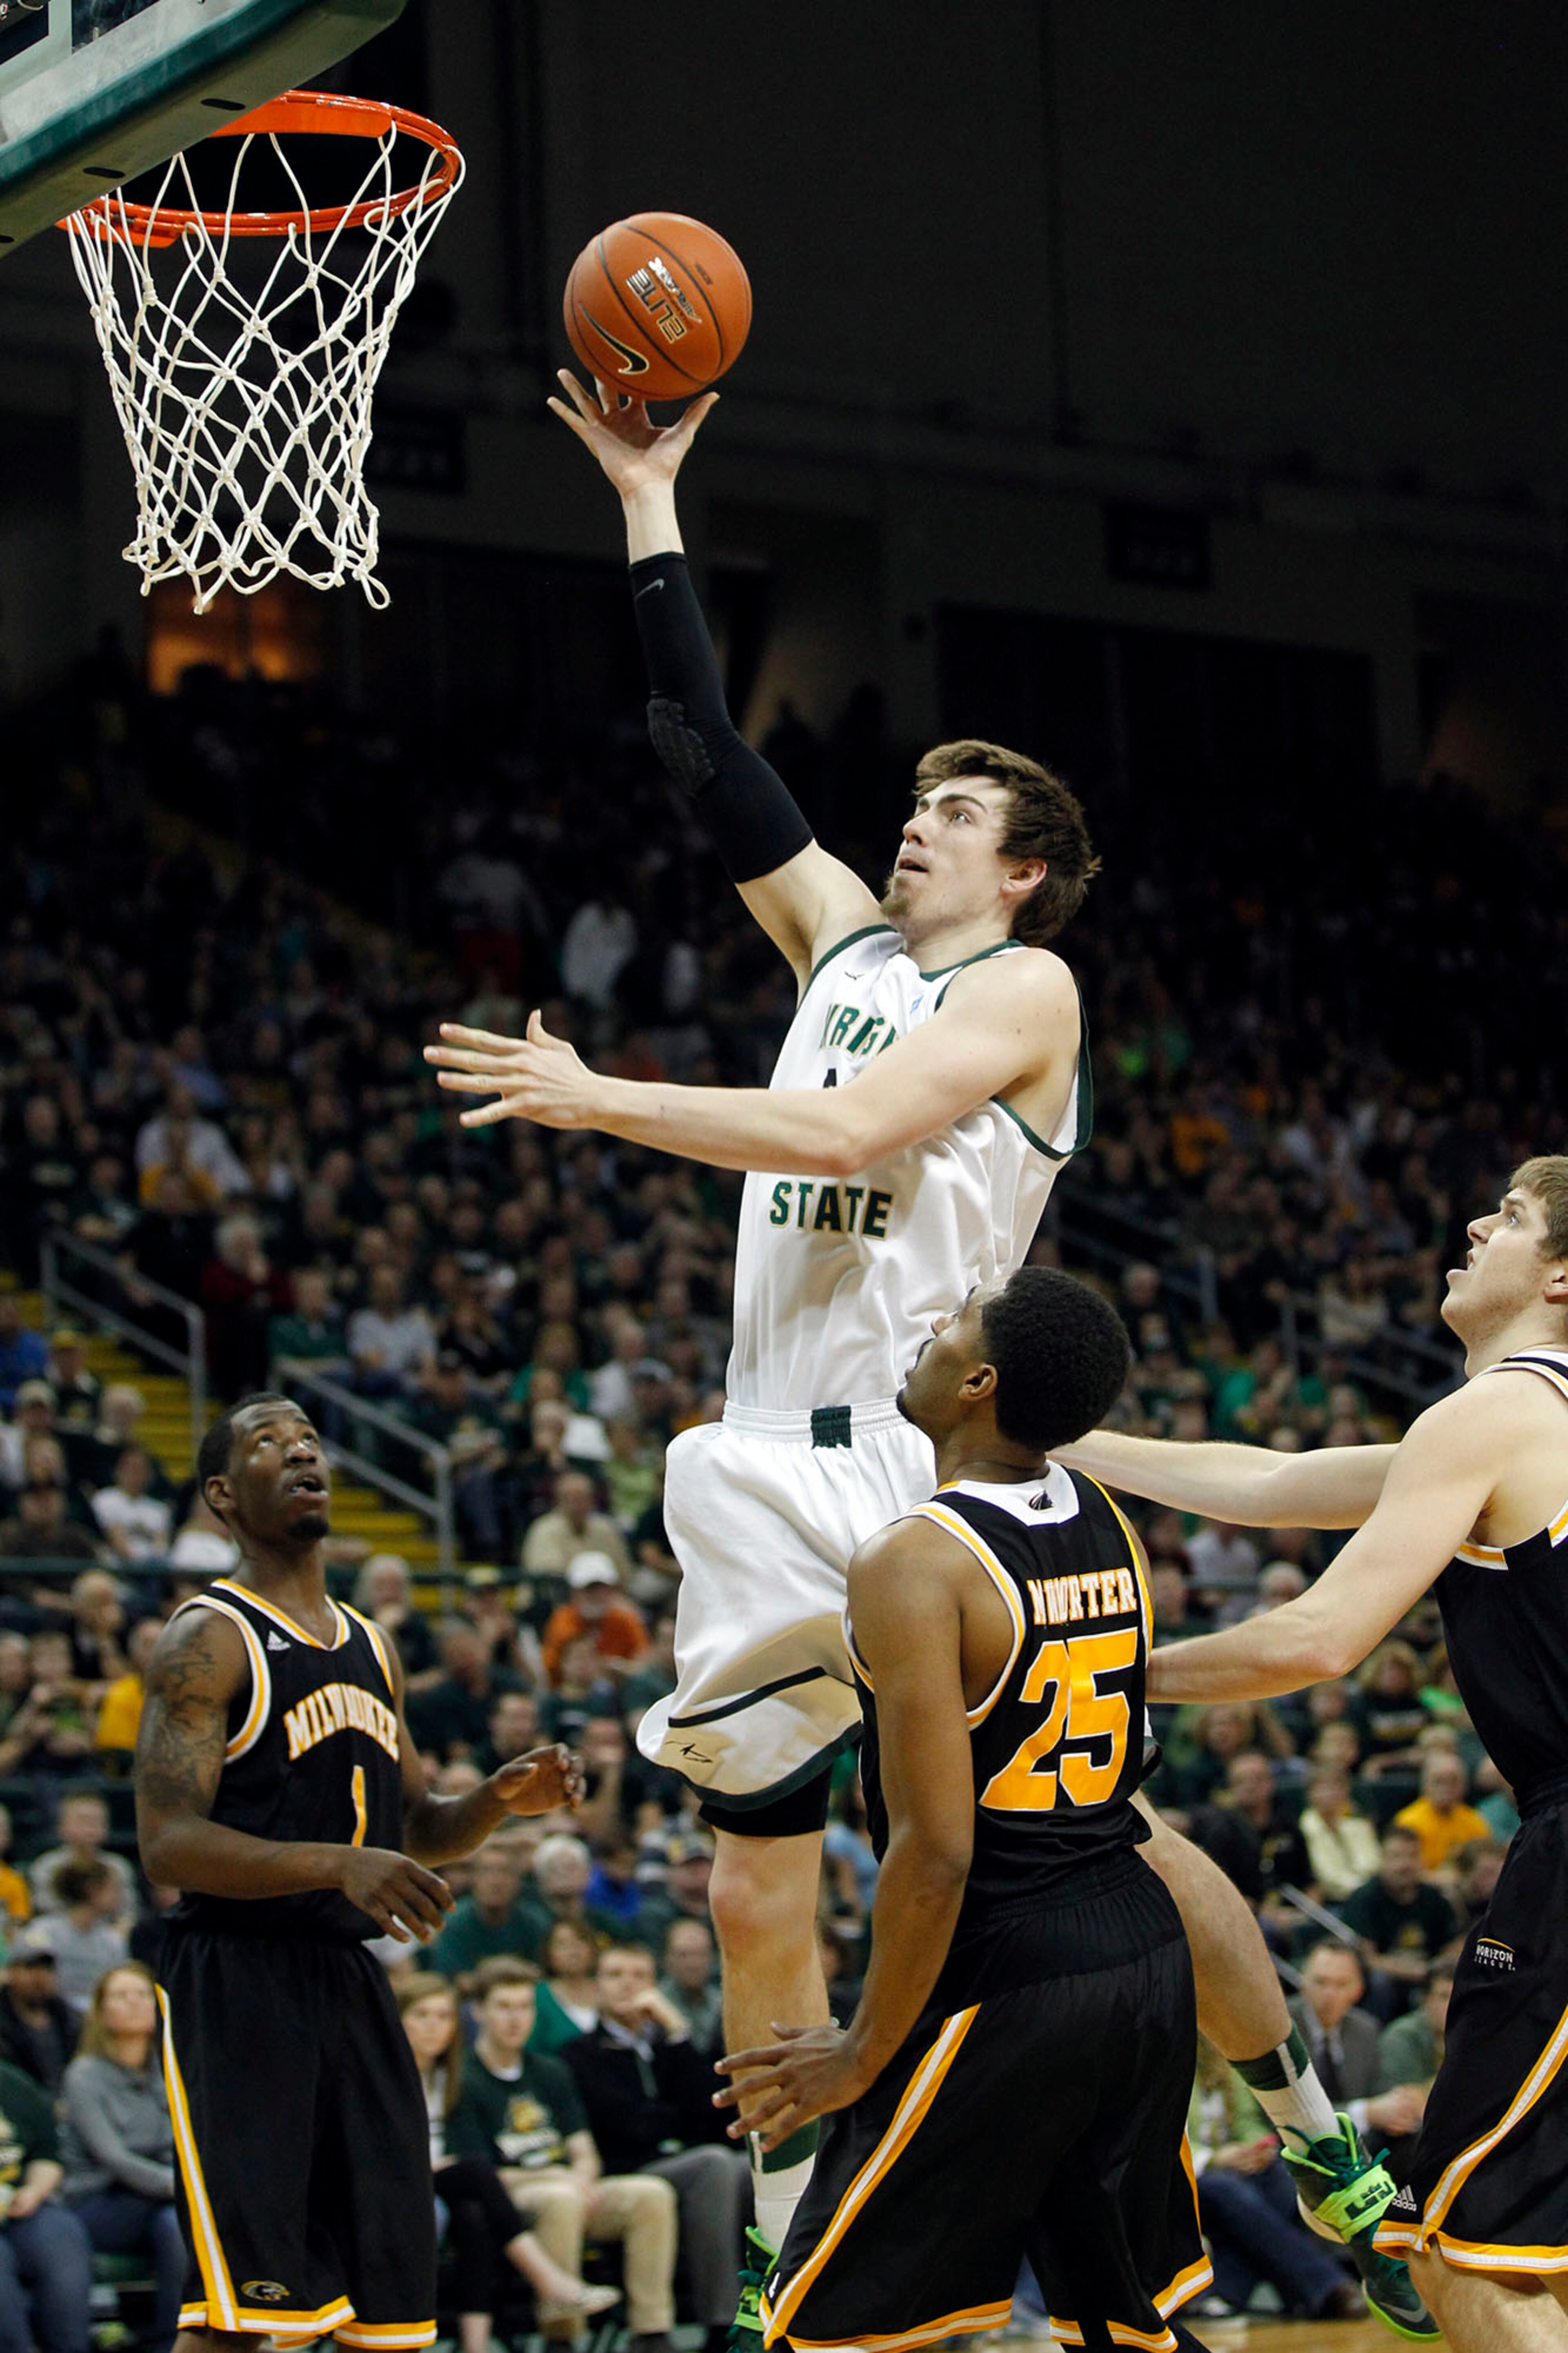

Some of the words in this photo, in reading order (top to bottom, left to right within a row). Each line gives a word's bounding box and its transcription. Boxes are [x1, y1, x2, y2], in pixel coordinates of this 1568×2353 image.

[626, 268, 687, 343] ELITE
[769, 1181, 894, 1241] STATE
[979, 1626, 1138, 1812] 25
[1476, 1945, 1513, 1963] HORIZON
[1392, 2198, 1417, 2211] adidas
